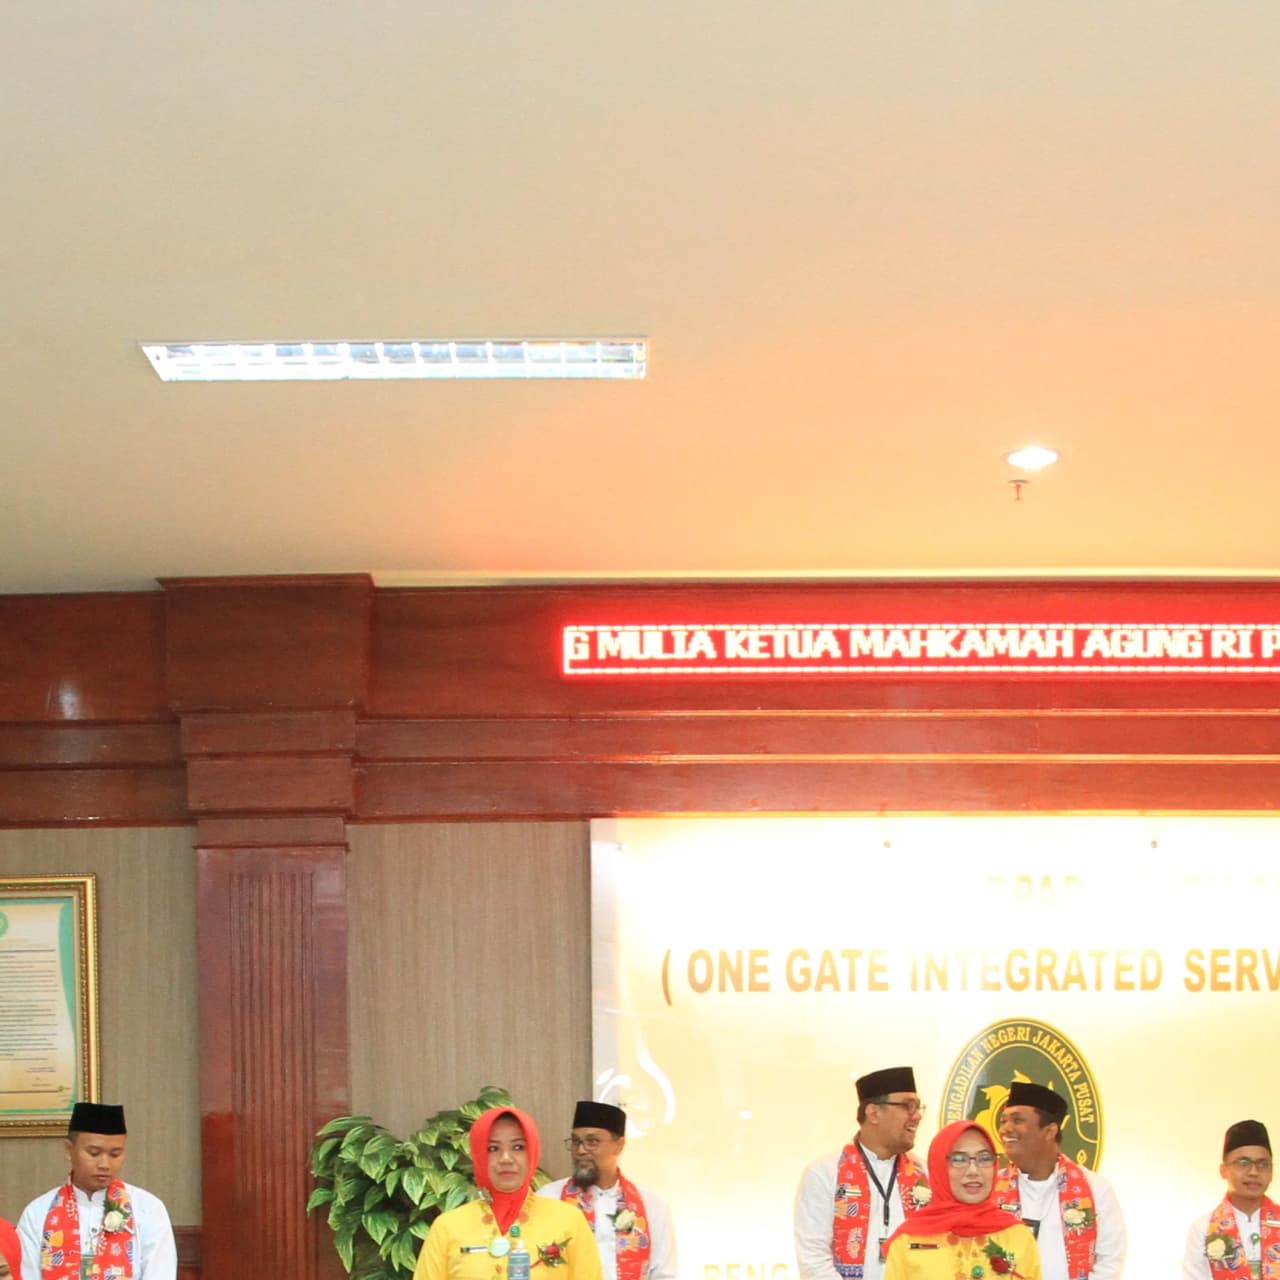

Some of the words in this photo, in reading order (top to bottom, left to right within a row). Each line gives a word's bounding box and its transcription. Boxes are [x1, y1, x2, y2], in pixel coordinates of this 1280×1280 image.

[597, 630, 716, 659] MULIA
[725, 630, 841, 659] KETUA
[850, 629, 1073, 658] MAHKAMAH
[1082, 630, 1203, 659] AGUNG
[1211, 630, 1255, 659] RI
[687, 948, 770, 993] ONE
[786, 948, 889, 992] GATE
[910, 947, 1162, 993] INTEGRATED
[981, 1026, 1030, 1054] NEGERI
[1032, 1031, 1082, 1082] JAKARTA
[1074, 1081, 1095, 1124] PUSAT
